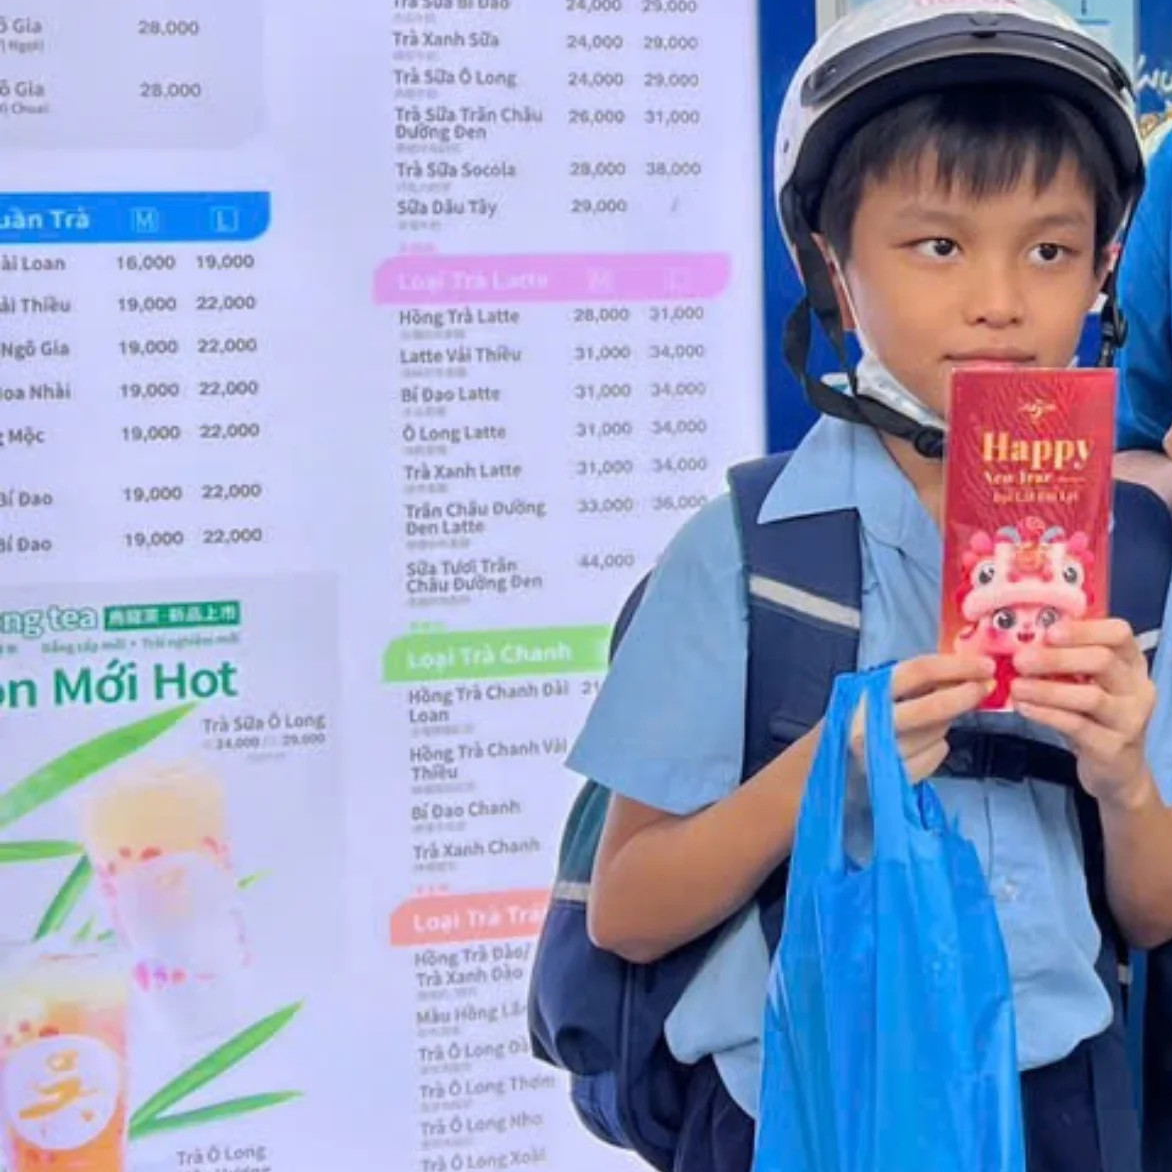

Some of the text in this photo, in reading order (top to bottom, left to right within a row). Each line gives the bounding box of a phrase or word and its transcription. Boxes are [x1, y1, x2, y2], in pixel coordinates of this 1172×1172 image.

[642, 0, 697, 13] 29,000
[13, 19, 199, 35] Gia 28,000
[393, 31, 698, 50] Trà Xanh Sữa 24,000 29,000
[394, 68, 699, 88] Trà Sữa Ô Long 24,000 29,000
[15, 82, 200, 98] Gia 28,000
[396, 107, 699, 125] Trà Sữa Trân Châu 26,000 31,000
[396, 162, 700, 178] Trà Sữa Socola 28,000 38,000
[21, 255, 254, 271] Loan 16,000 19,000
[21, 295, 255, 313] Thiều 19,000 22,000
[400, 307, 704, 327] Hồng Trà Latte 28,000 31,000
[41, 341, 69, 356] Gia
[119, 340, 178, 355] 19,000
[197, 339, 257, 353] 22,000
[401, 386, 418, 403] Bí
[459, 387, 500, 401] Latte
[575, 385, 631, 399] 31,000
[651, 383, 706, 397] 34,000
[8, 424, 260, 446] Mộc 19,000 22,000
[403, 421, 707, 443] Ô Long Latte 31,000 34,000
[983, 431, 1089, 471] Happy
[405, 458, 707, 480] Trà Xanh Latte 31,000 34,000
[125, 532, 184, 547] 19,000
[203, 530, 262, 544] 22,000
[407, 553, 635, 576] Sữa Tươi Trân 44,000
[49, 605, 97, 630] tea
[54, 658, 138, 706] Mới
[154, 661, 238, 700] Hot
[412, 800, 427, 820] Bí
[468, 799, 520, 817] Chanh
[414, 836, 540, 859] Trà Xanh Chanh
